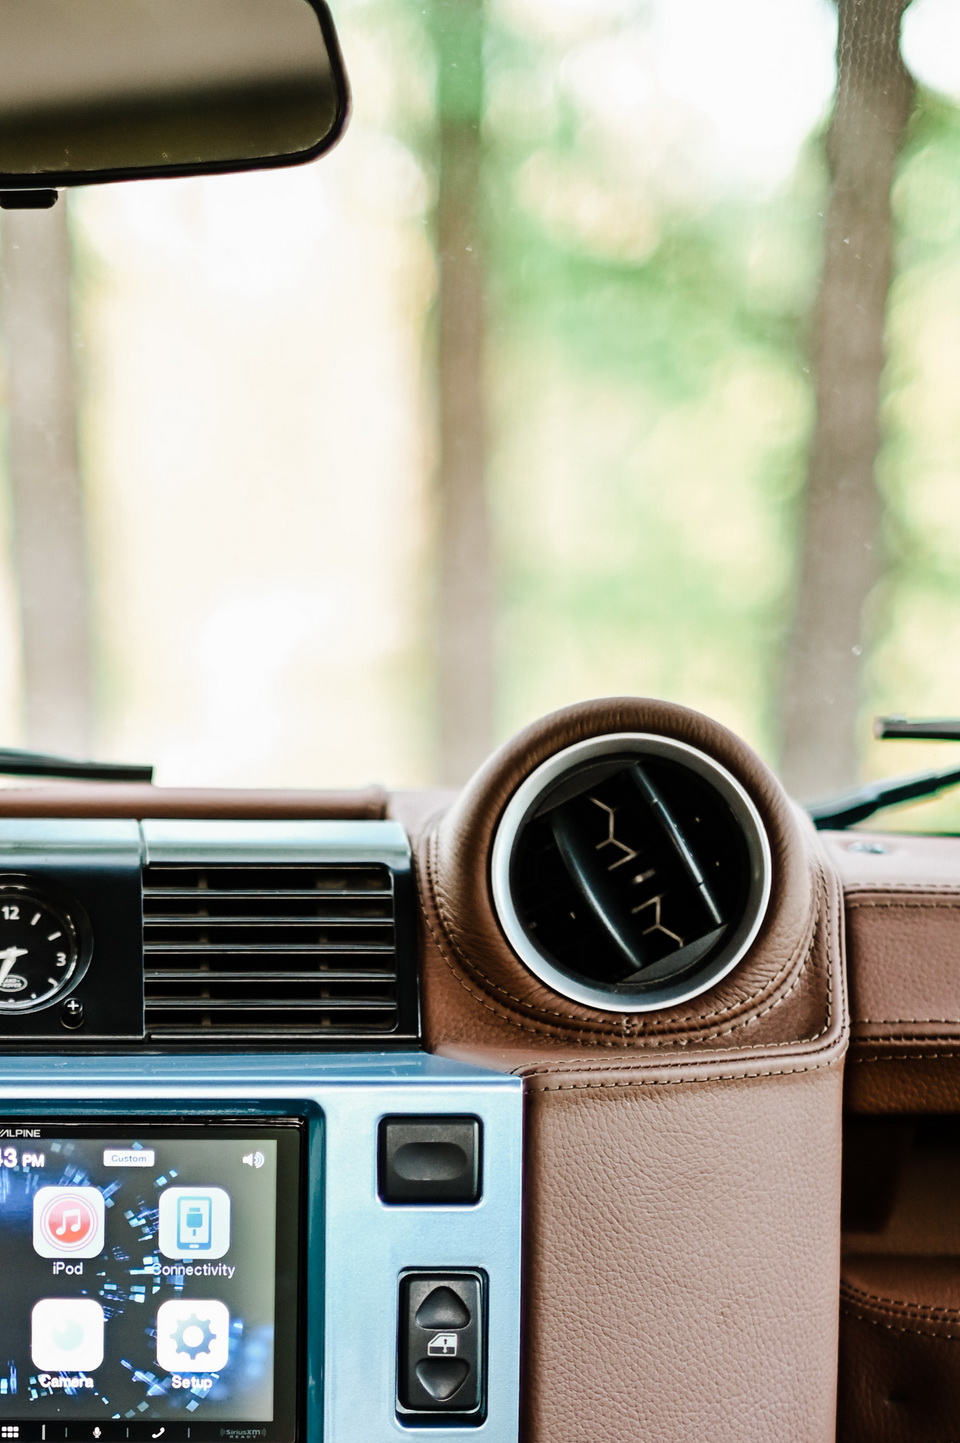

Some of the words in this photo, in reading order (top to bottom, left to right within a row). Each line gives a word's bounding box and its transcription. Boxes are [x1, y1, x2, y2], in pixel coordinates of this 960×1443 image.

[1, 905, 20, 920] 12
[56, 952, 67, 967] 3
[2, 1129, 41, 1138] ALPINE
[22, 1153, 45, 1168] PM
[110, 1154, 148, 1163] Custom
[52, 1261, 84, 1276] iPod
[152, 1262, 236, 1279] Connectivity
[39, 1373, 94, 1389] Camera
[171, 1375, 213, 1390] Setup
